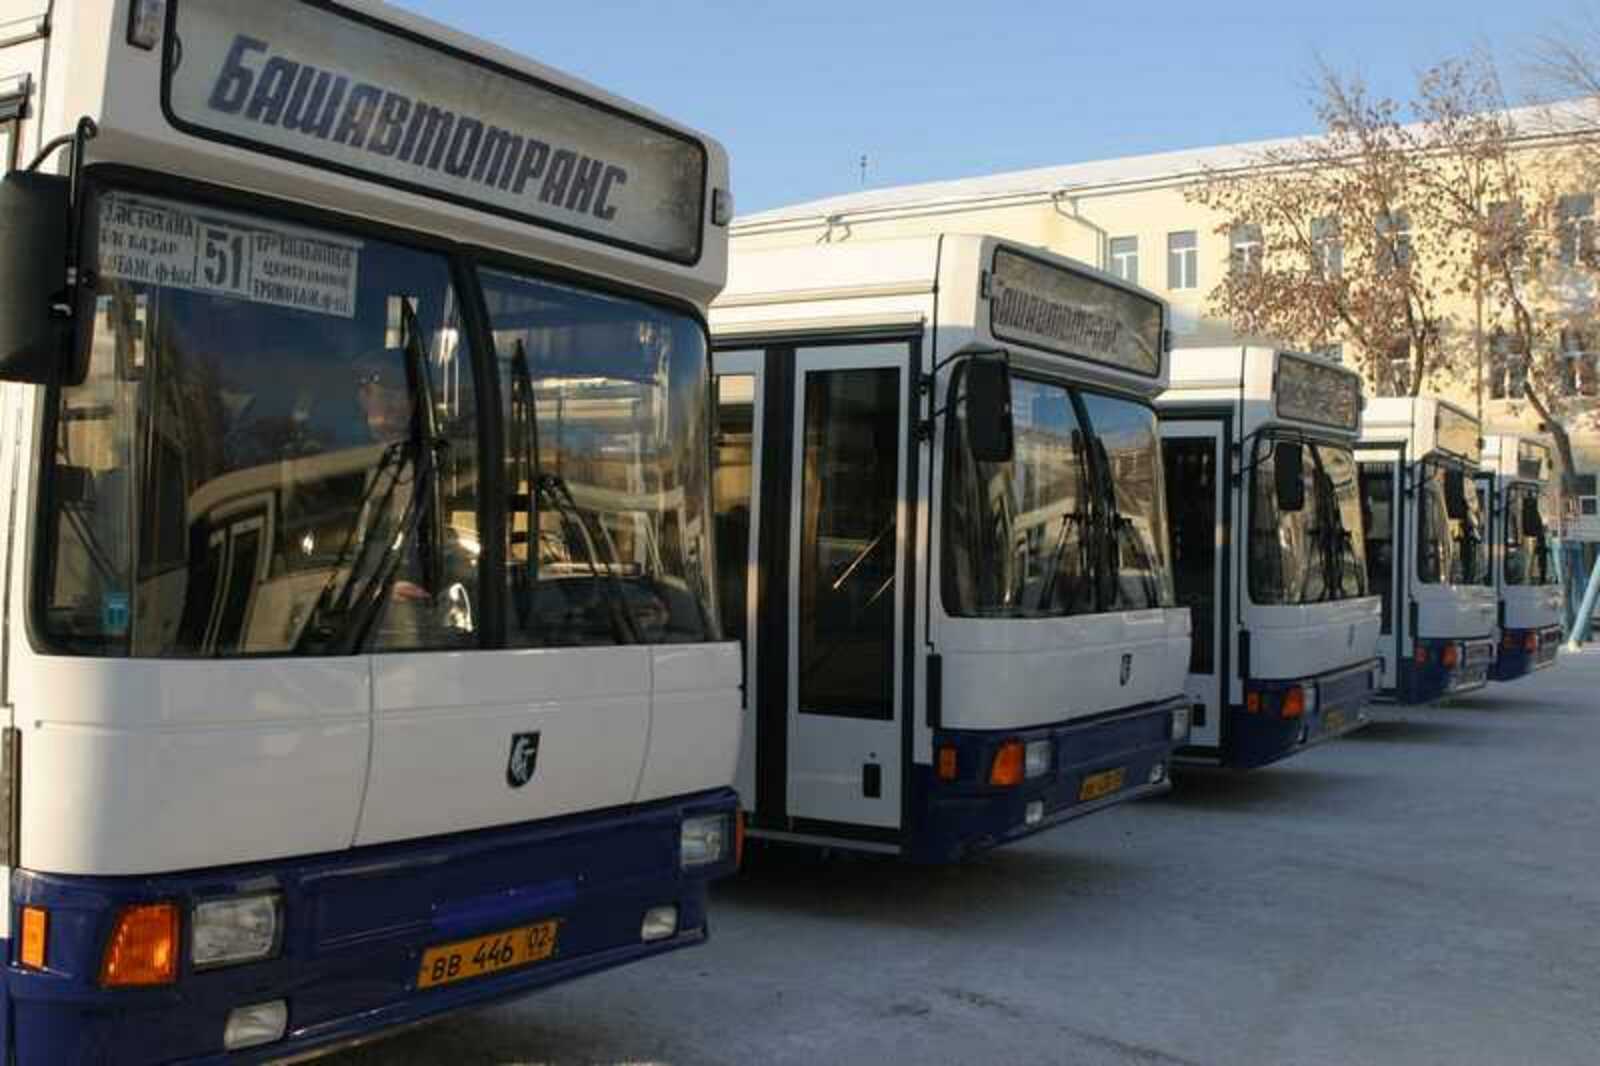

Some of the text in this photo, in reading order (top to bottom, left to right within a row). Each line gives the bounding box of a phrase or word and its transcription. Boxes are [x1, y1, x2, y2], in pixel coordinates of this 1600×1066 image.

[208, 33, 627, 220] БАШАВТОТРАНС
[204, 227, 243, 289] 51
[472, 935, 513, 969] 446
